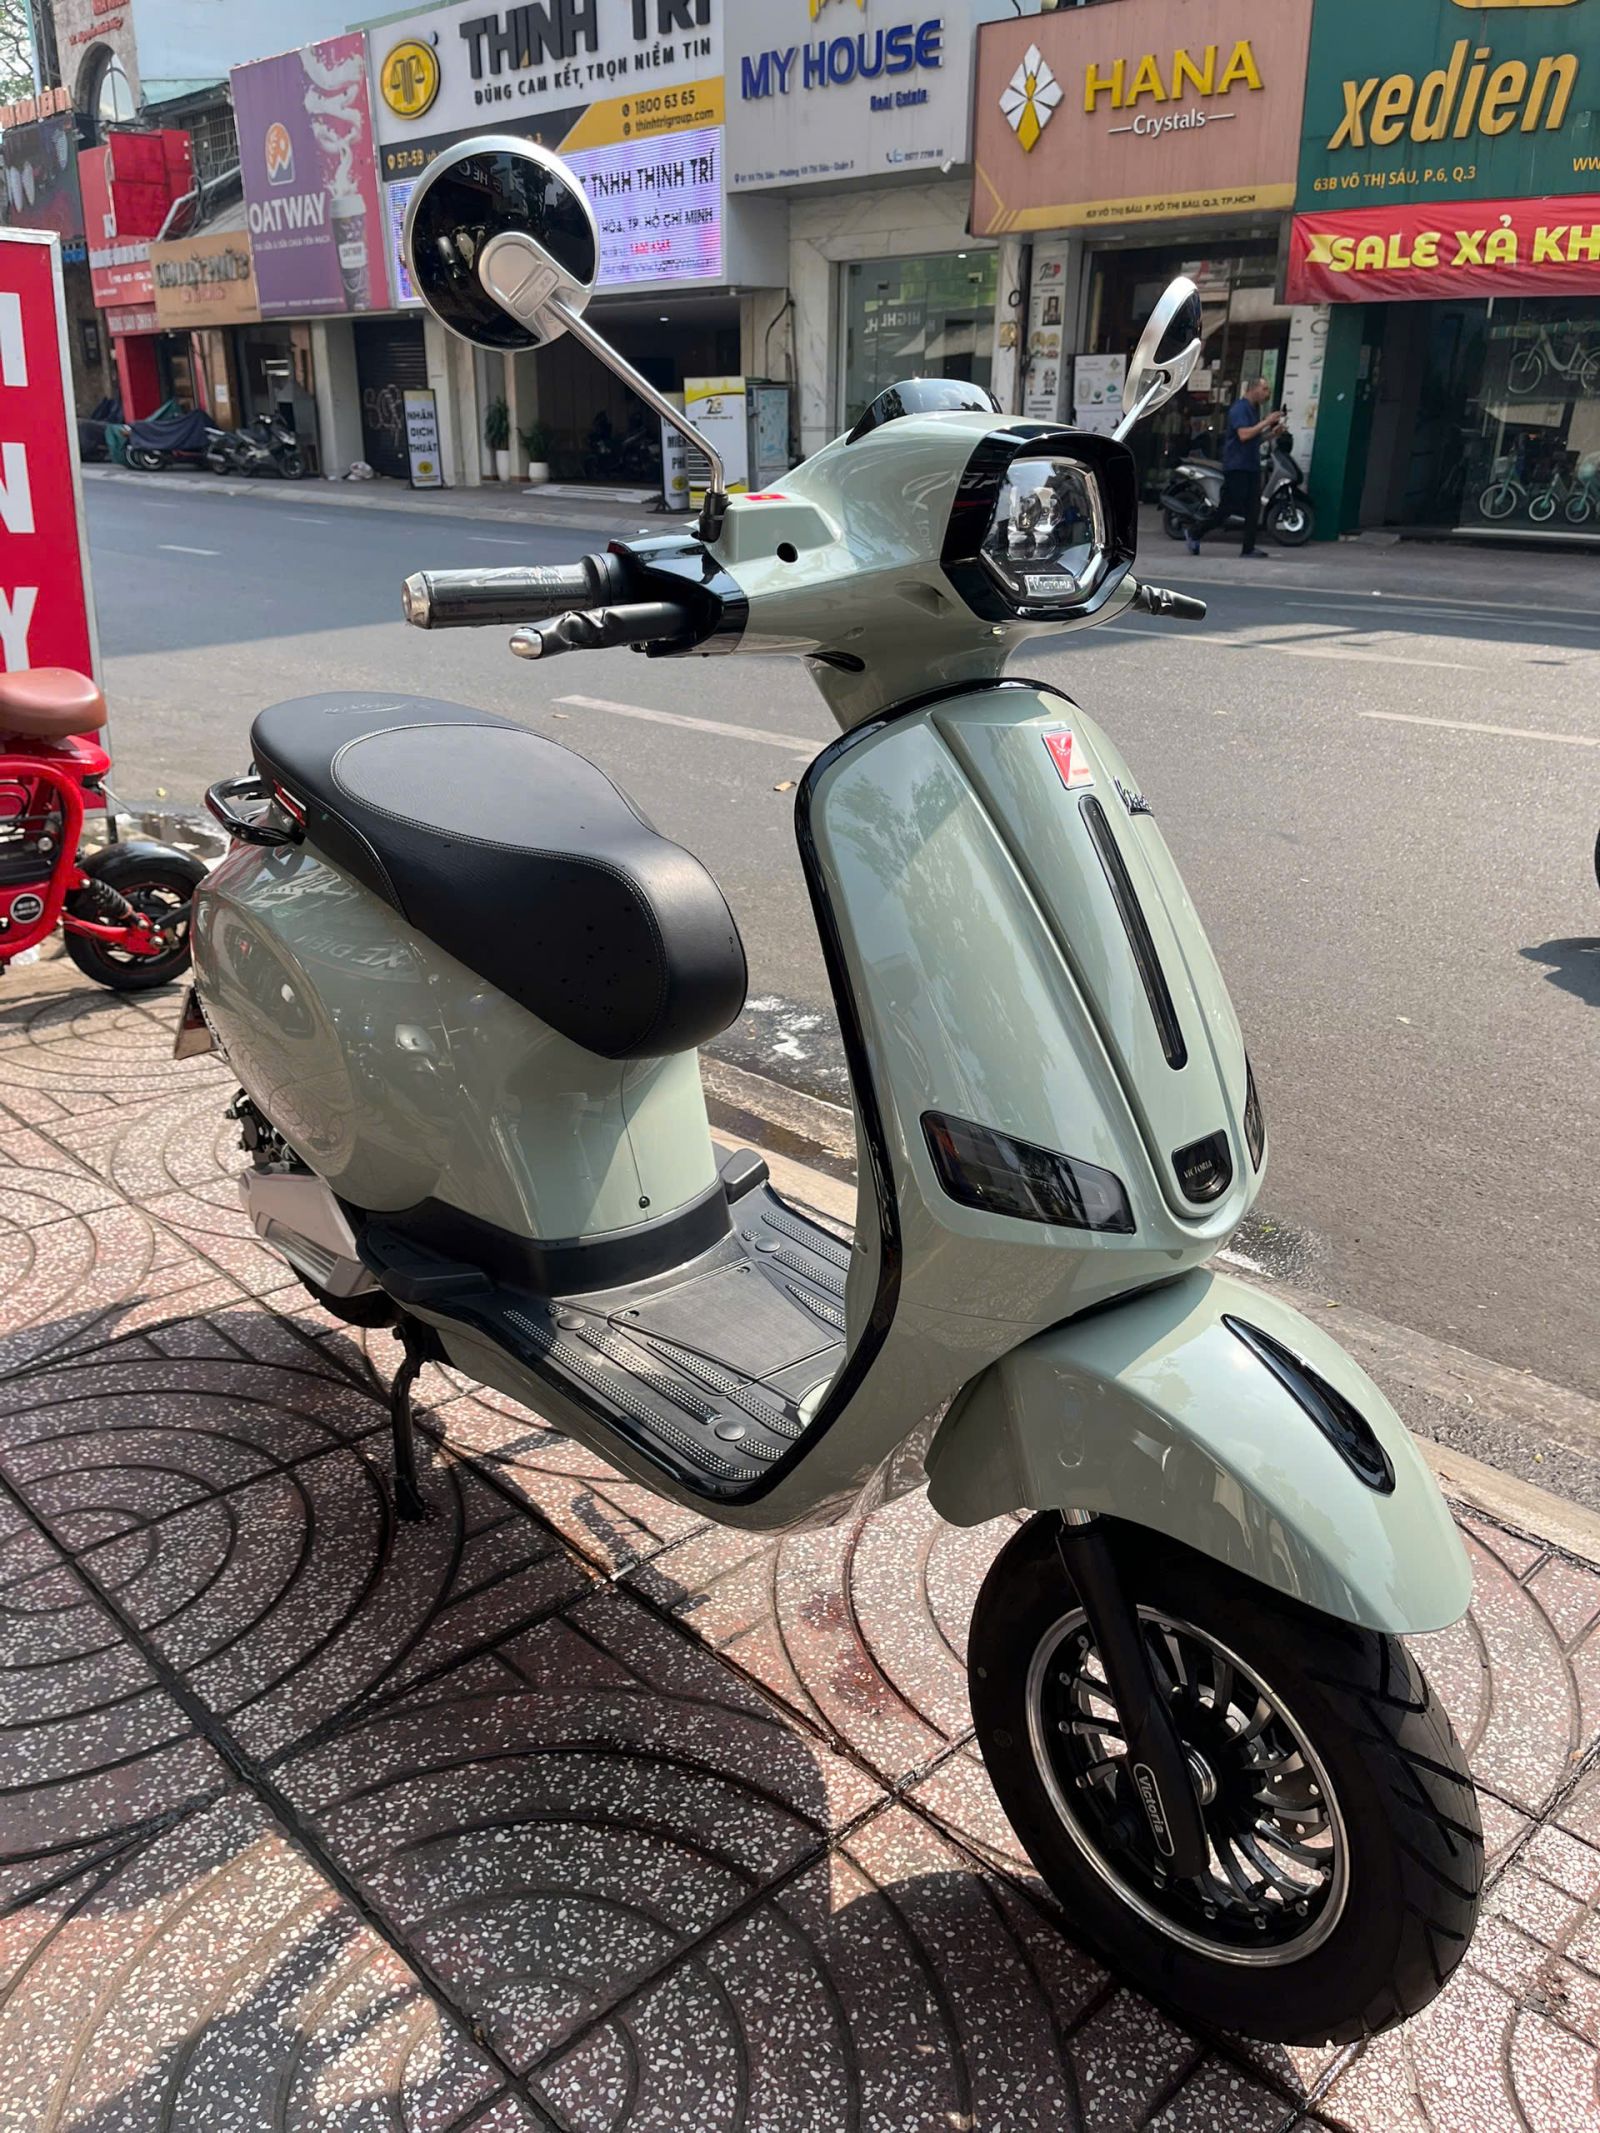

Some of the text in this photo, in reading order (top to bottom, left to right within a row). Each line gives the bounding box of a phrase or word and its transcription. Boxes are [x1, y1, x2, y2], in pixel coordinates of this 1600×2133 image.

[518, 75, 548, 97] CAM
[588, 57, 627, 83] TRỌN
[683, 37, 711, 60] TIN
[741, 19, 944, 101] MY HOUSE
[1084, 40, 1264, 112] HANA
[635, 90, 695, 115] 1800 63 65
[896, 88, 929, 108] Estate
[1327, 38, 1580, 150] xedien
[1133, 108, 1206, 139] Crystals
[1313, 176, 1338, 192] 63B
[1341, 172, 1360, 189] VÕ
[1364, 172, 1385, 190] THỊ
[1452, 166, 1476, 182] Q.3
[249, 191, 325, 234] OATWAY
[1328, 231, 1443, 273] SALE
[1451, 214, 1518, 268] XẢ
[1139, 1776, 1164, 1834] Victoria
